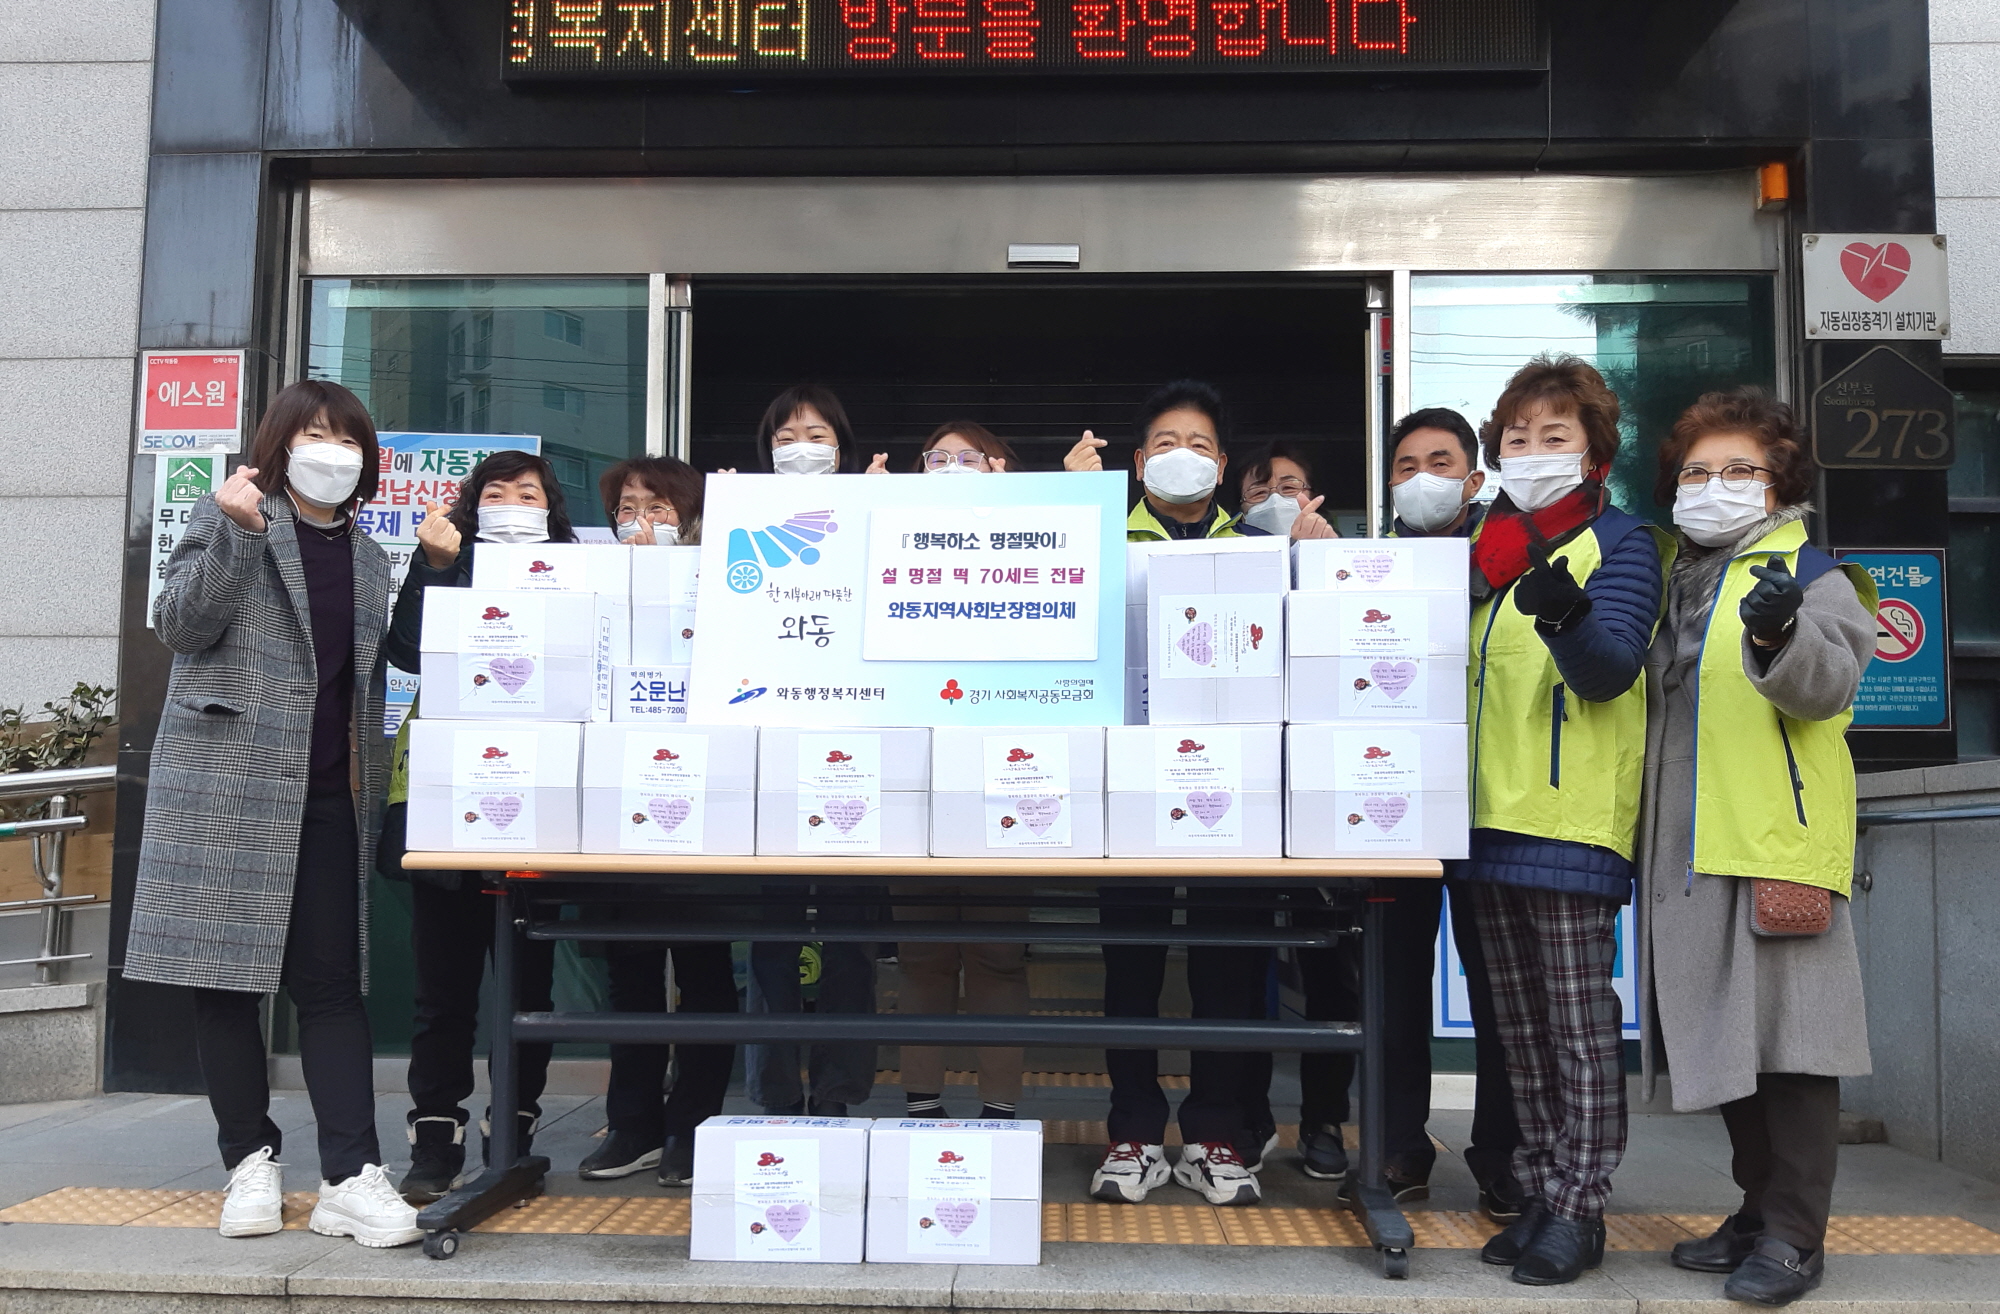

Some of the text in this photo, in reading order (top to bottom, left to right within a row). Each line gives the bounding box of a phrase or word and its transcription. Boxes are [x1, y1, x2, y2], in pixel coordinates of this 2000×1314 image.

[841, 0, 1041, 60] 방문을
[1071, 0, 1418, 58] 환영합니다
[1820, 311, 1937, 332] 자동심장충격기 설치기관
[158, 380, 226, 408] 에스원
[1836, 381, 1875, 395] 선부로
[1823, 396, 1875, 406] Seonbu-ro
[144, 434, 197, 449] SECOM
[1845, 408, 1950, 460] 273
[880, 567, 1086, 585] 설 명절 떡 70세트 전달
[766, 581, 781, 603] 한
[823, 586, 853, 603] 따뜻한
[887, 601, 1077, 620] 와동지역사회보장협의체
[777, 614, 836, 648] 와동
[629, 680, 687, 702] 소문난
[776, 687, 885, 701] 와동행정복지센터
[969, 689, 1094, 705] 경기 사회복지공동모금회
